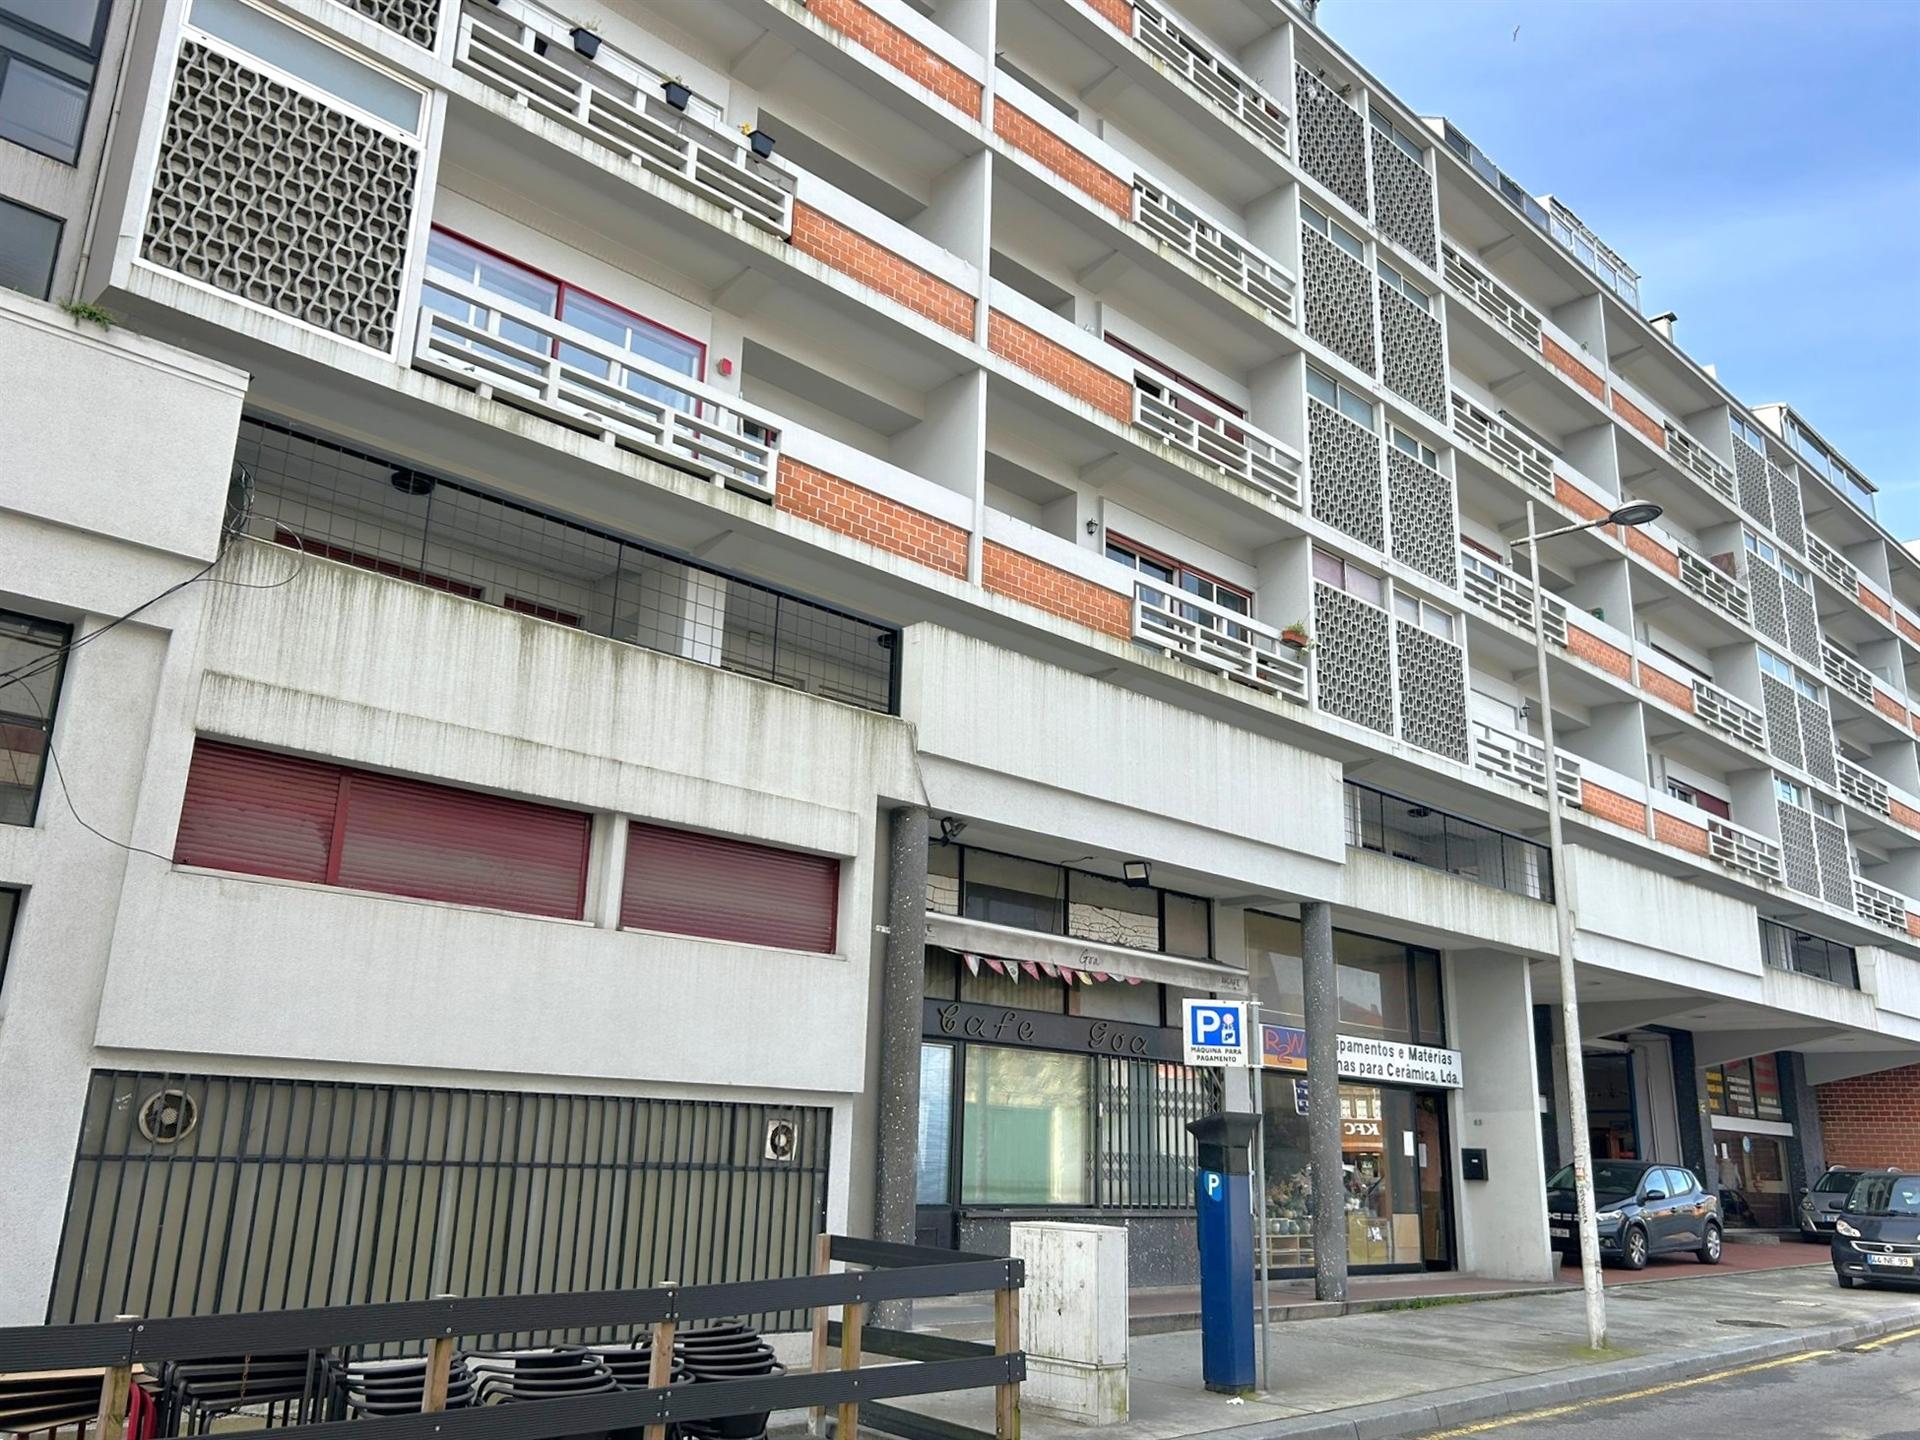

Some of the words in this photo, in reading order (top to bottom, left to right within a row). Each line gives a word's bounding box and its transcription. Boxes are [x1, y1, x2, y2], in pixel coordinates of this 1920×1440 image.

[1196, 1009, 1220, 1043] P
[1088, 1021, 1148, 1055] Goa
[1196, 1054, 1237, 1063] PAGAMENTO
[1398, 1048, 1404, 1059] e
[1408, 1046, 1452, 1065] Matérias
[1360, 1062, 1384, 1076] para
[1440, 1069, 1460, 1085] Lda.
[1208, 1173, 1220, 1196] P
